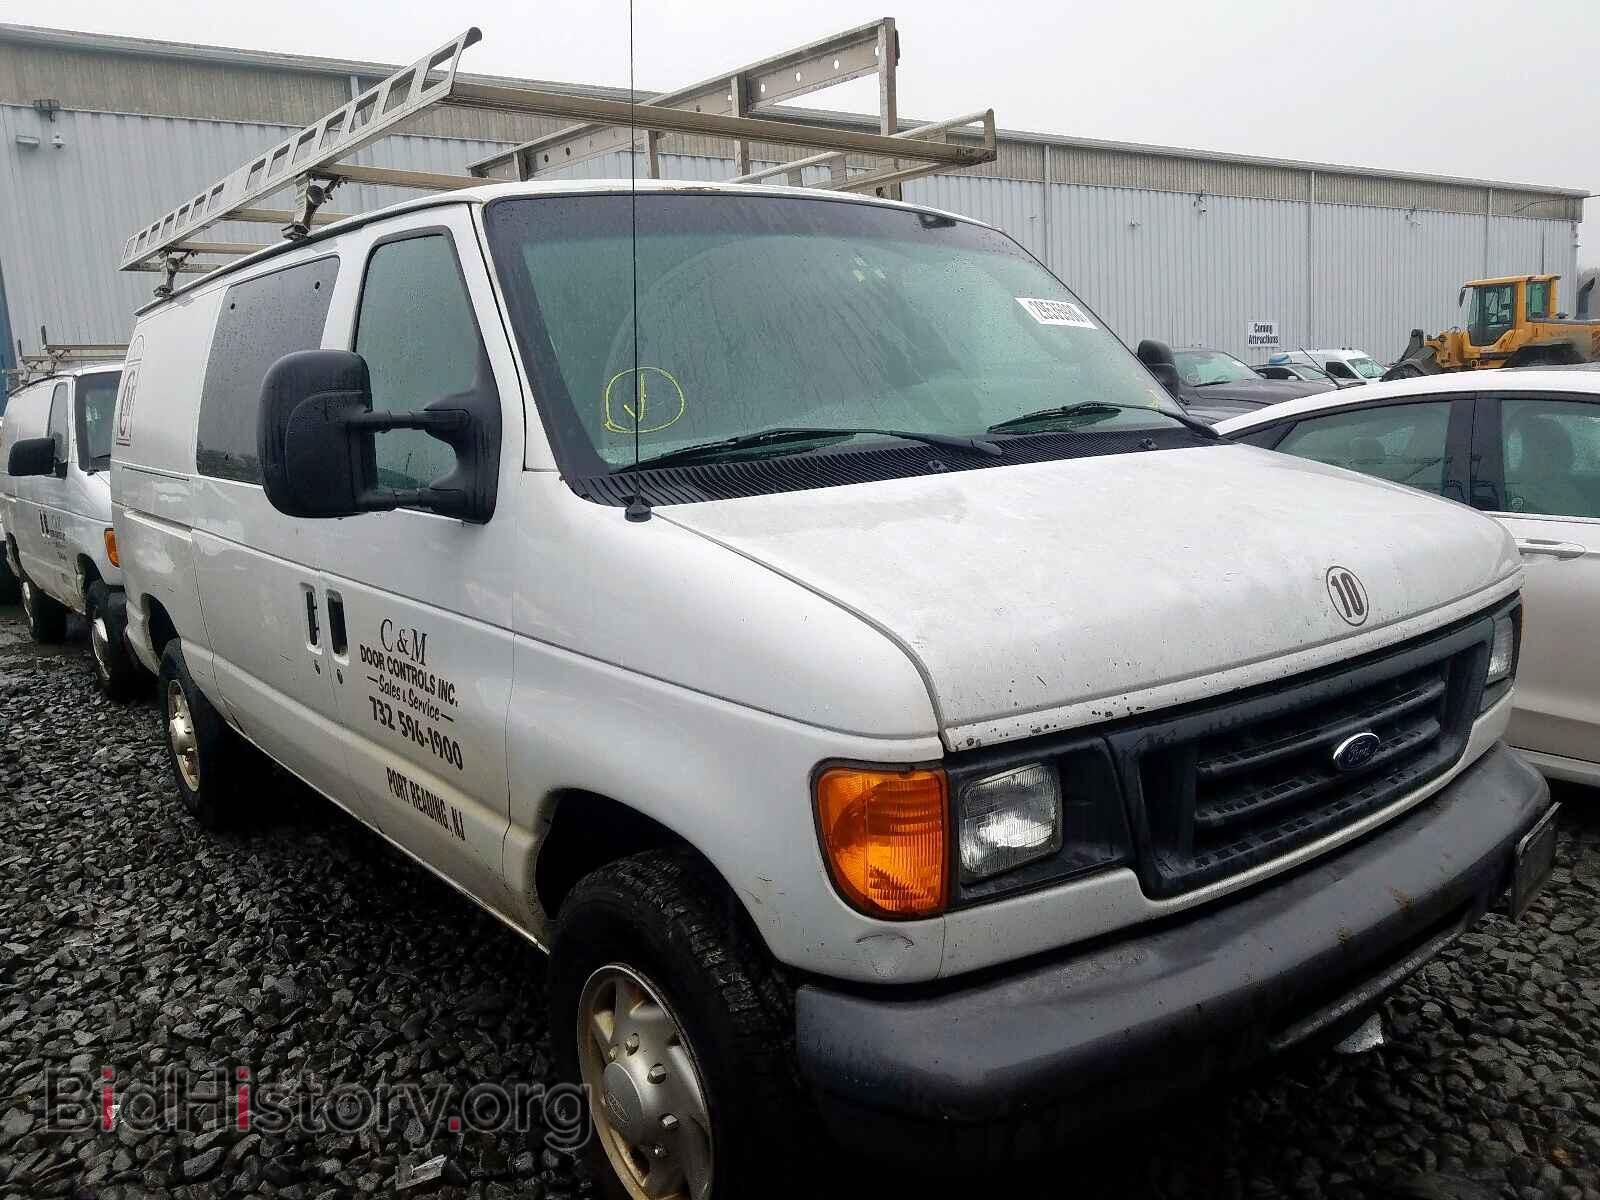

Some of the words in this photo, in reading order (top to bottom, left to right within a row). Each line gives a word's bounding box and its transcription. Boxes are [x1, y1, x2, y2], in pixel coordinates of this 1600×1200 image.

[1331, 572, 1365, 617] 10
[380, 618, 394, 652] C
[397, 628, 410, 656] &
[410, 628, 428, 667] M
[360, 643, 386, 672] DOOR
[387, 655, 436, 696] CONTROLS
[438, 678, 459, 707] INC.
[379, 674, 401, 701] Sales
[408, 687, 440, 722] Service
[368, 695, 396, 731] 732
[397, 710, 464, 771] 596-1900
[386, 766, 411, 804] PORT
